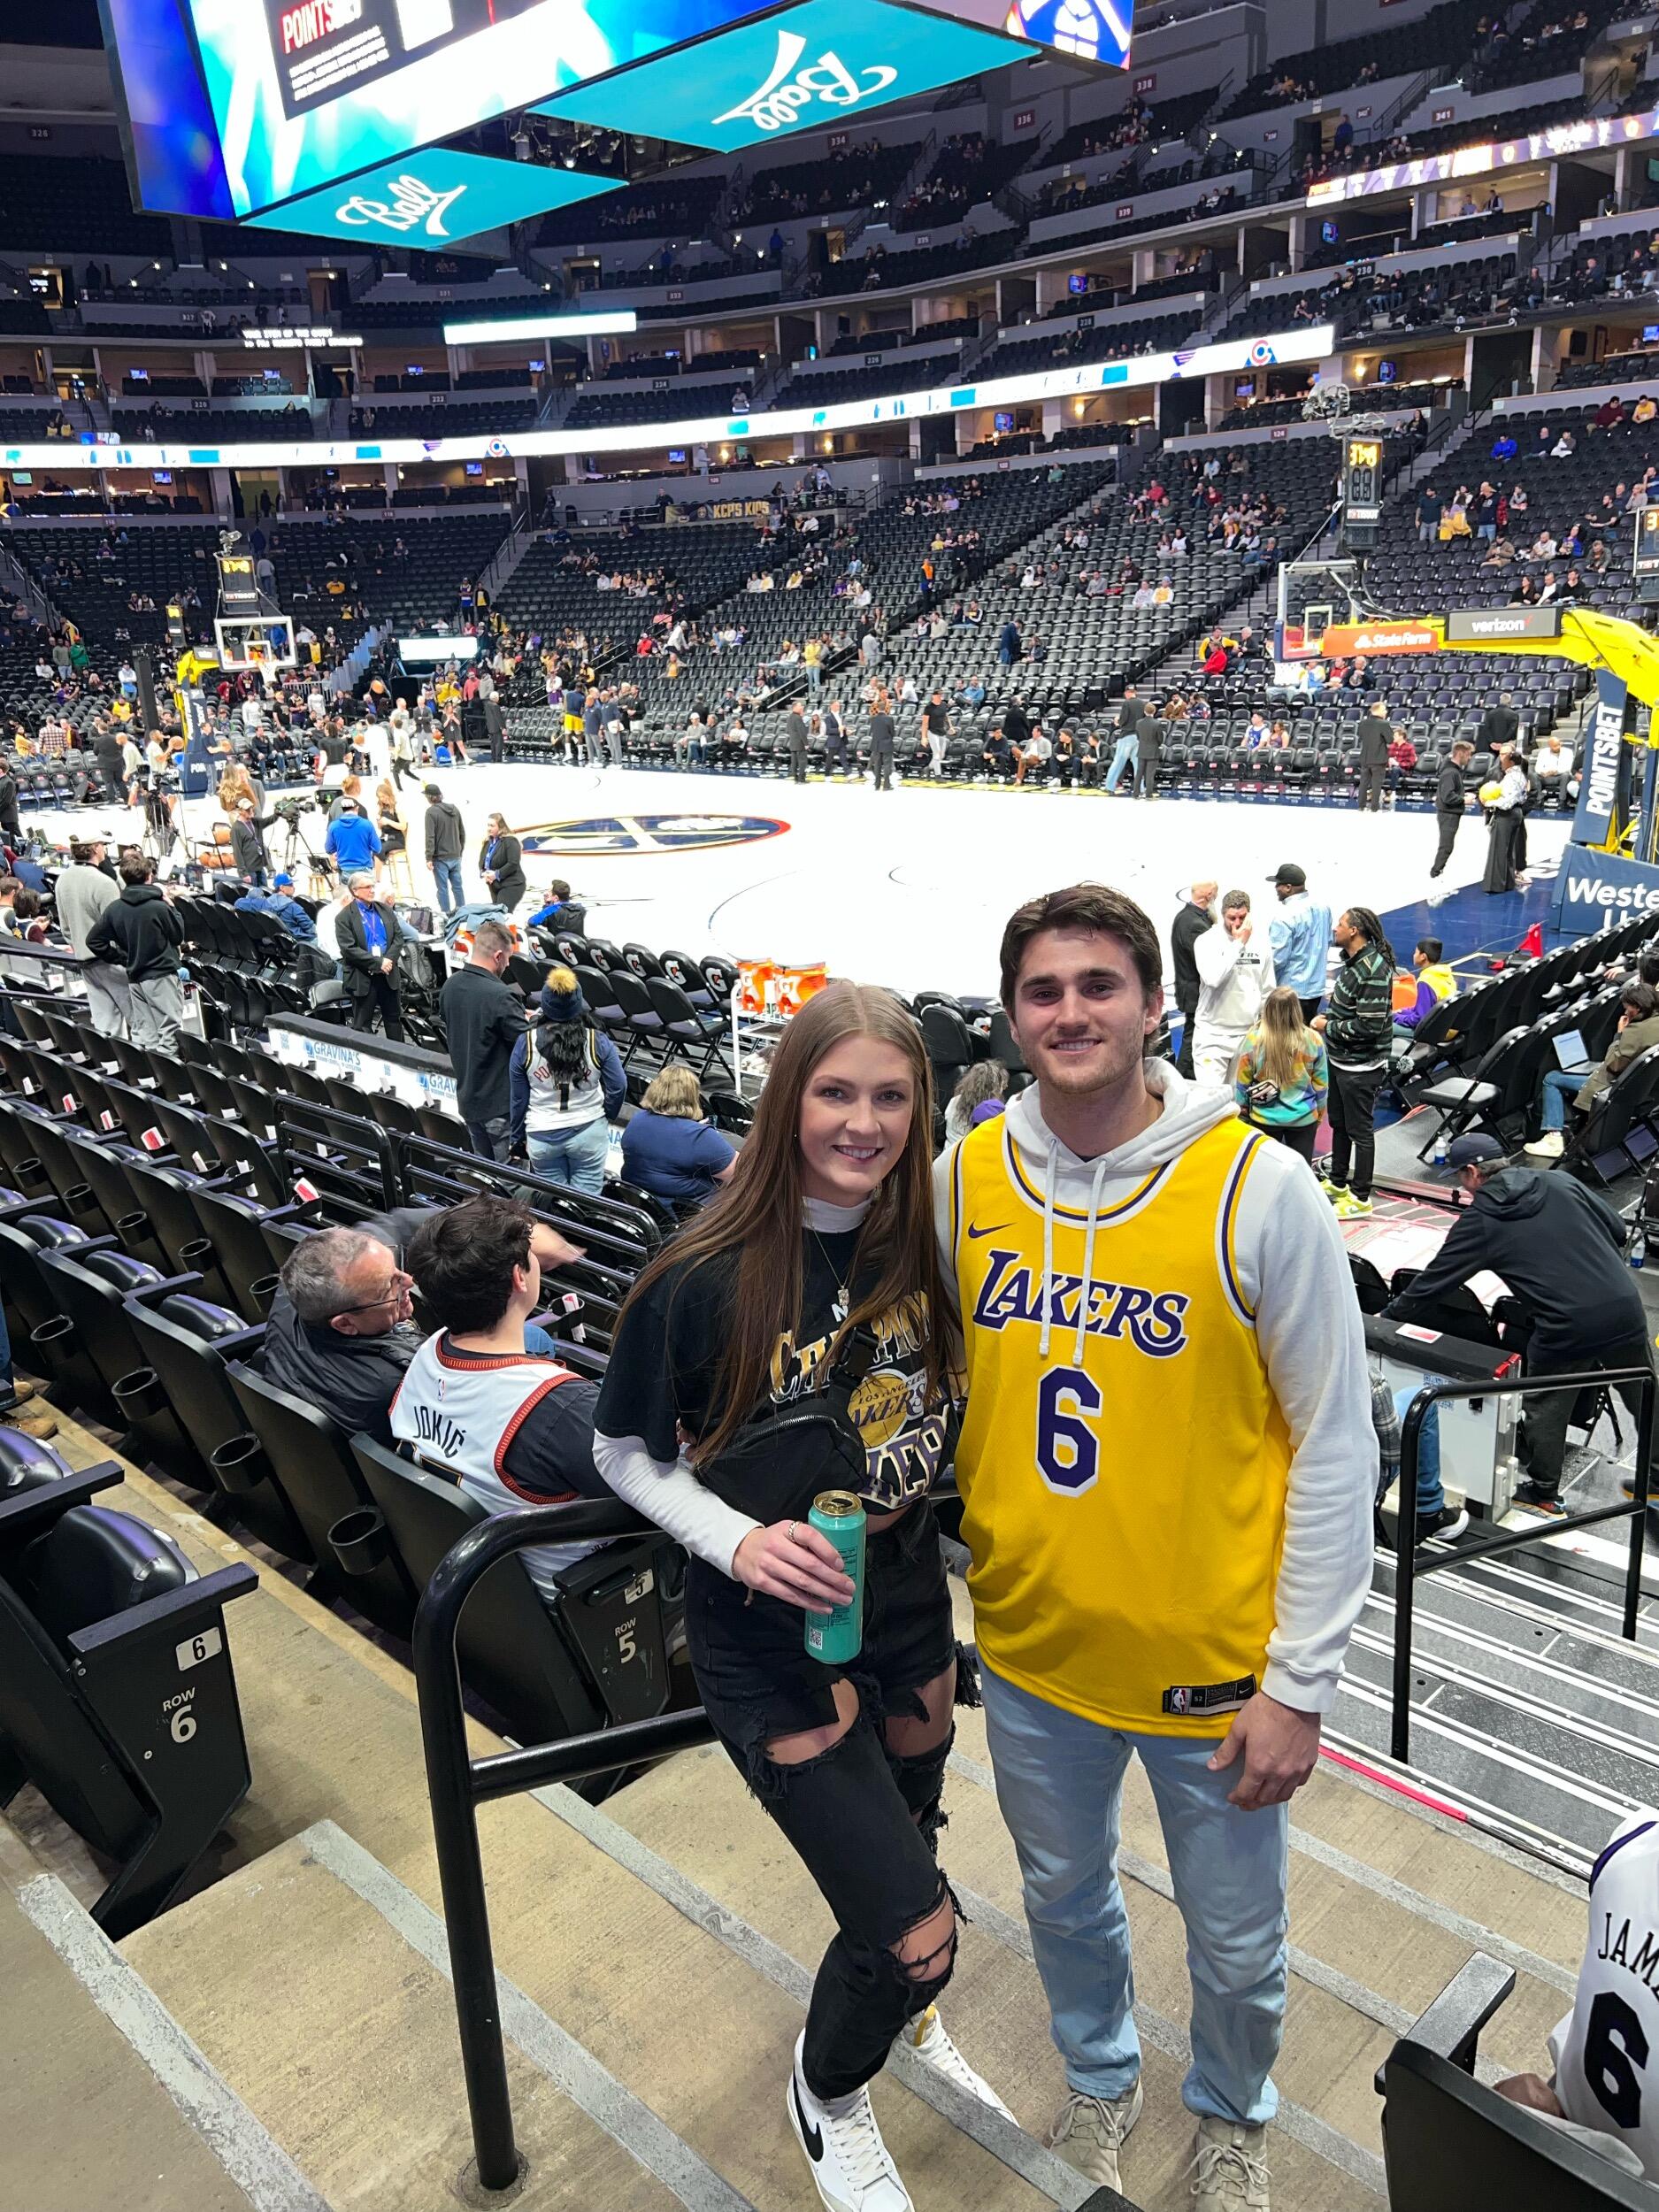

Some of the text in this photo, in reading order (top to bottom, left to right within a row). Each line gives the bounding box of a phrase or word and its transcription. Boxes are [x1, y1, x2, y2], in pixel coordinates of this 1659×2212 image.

[711, 29, 898, 130] Ball
[335, 175, 468, 236] Ball
[1373, 632, 1431, 648] State Farm
[1472, 618, 1525, 633] verizon
[1586, 702, 1624, 817] POINTSBET
[313, 1041, 362, 1066] GRAVINA'S
[972, 1248, 1193, 1359] LAKERS
[858, 1392, 880, 1405] LOS
[412, 1405, 467, 1459] JOKIĆ
[1034, 1363, 1104, 1499] 6
[614, 1617, 637, 1637] ROW
[618, 1630, 636, 1664] 5
[192, 1636, 206, 1662] 6
[163, 1686, 196, 1712] ROW
[170, 1704, 197, 1744] 6
[1597, 1912, 1659, 2002] JAM
[1584, 1991, 1650, 2129] 6
